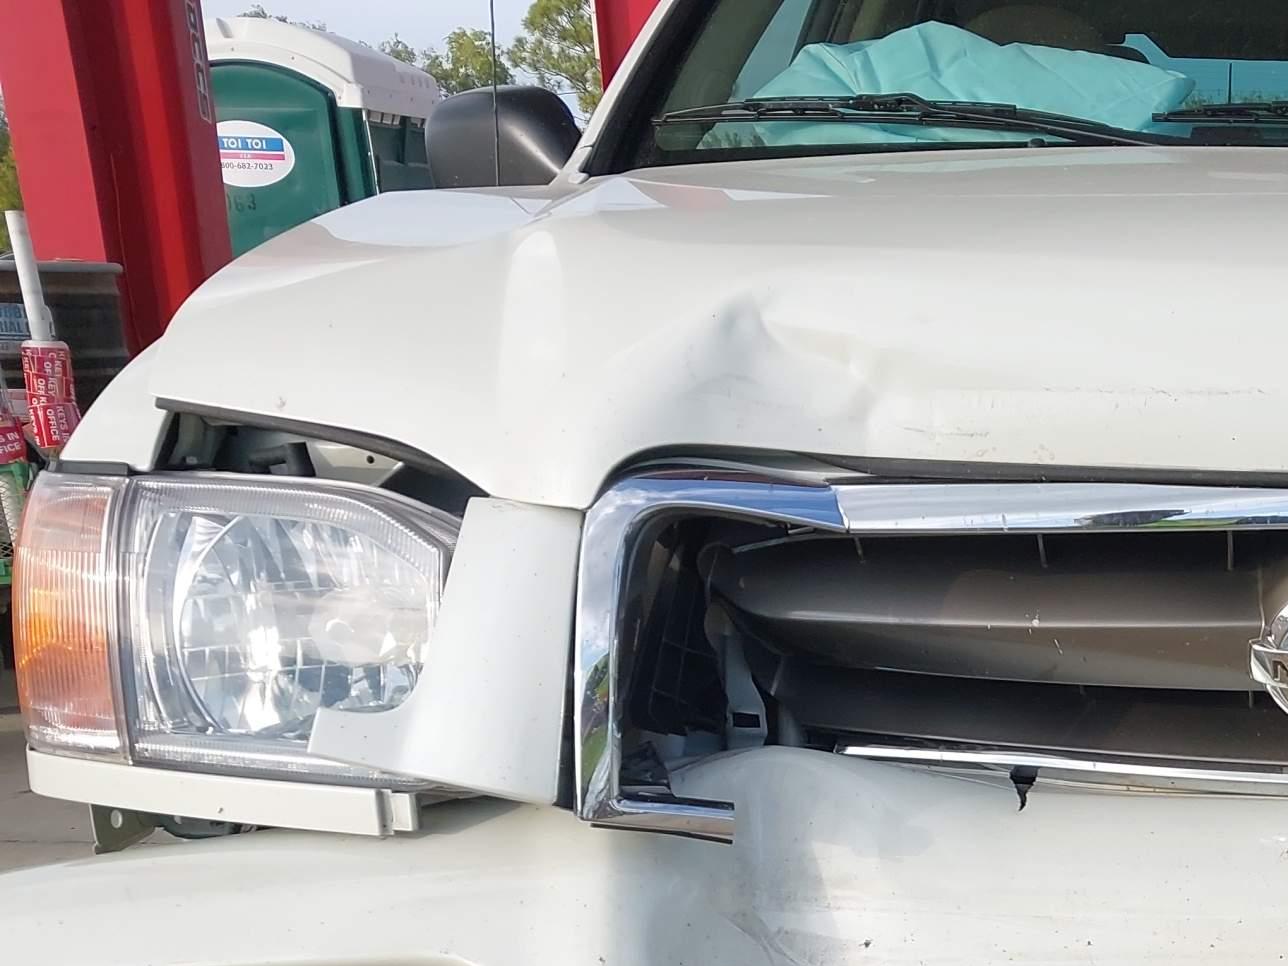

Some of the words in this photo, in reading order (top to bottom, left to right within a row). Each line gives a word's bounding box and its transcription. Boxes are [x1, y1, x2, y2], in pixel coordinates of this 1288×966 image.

[222, 137, 241, 149] TOI
[246, 138, 266, 150] TOI
[46, 408, 60, 441] OFFICE
[6, 431, 20, 441] IN
